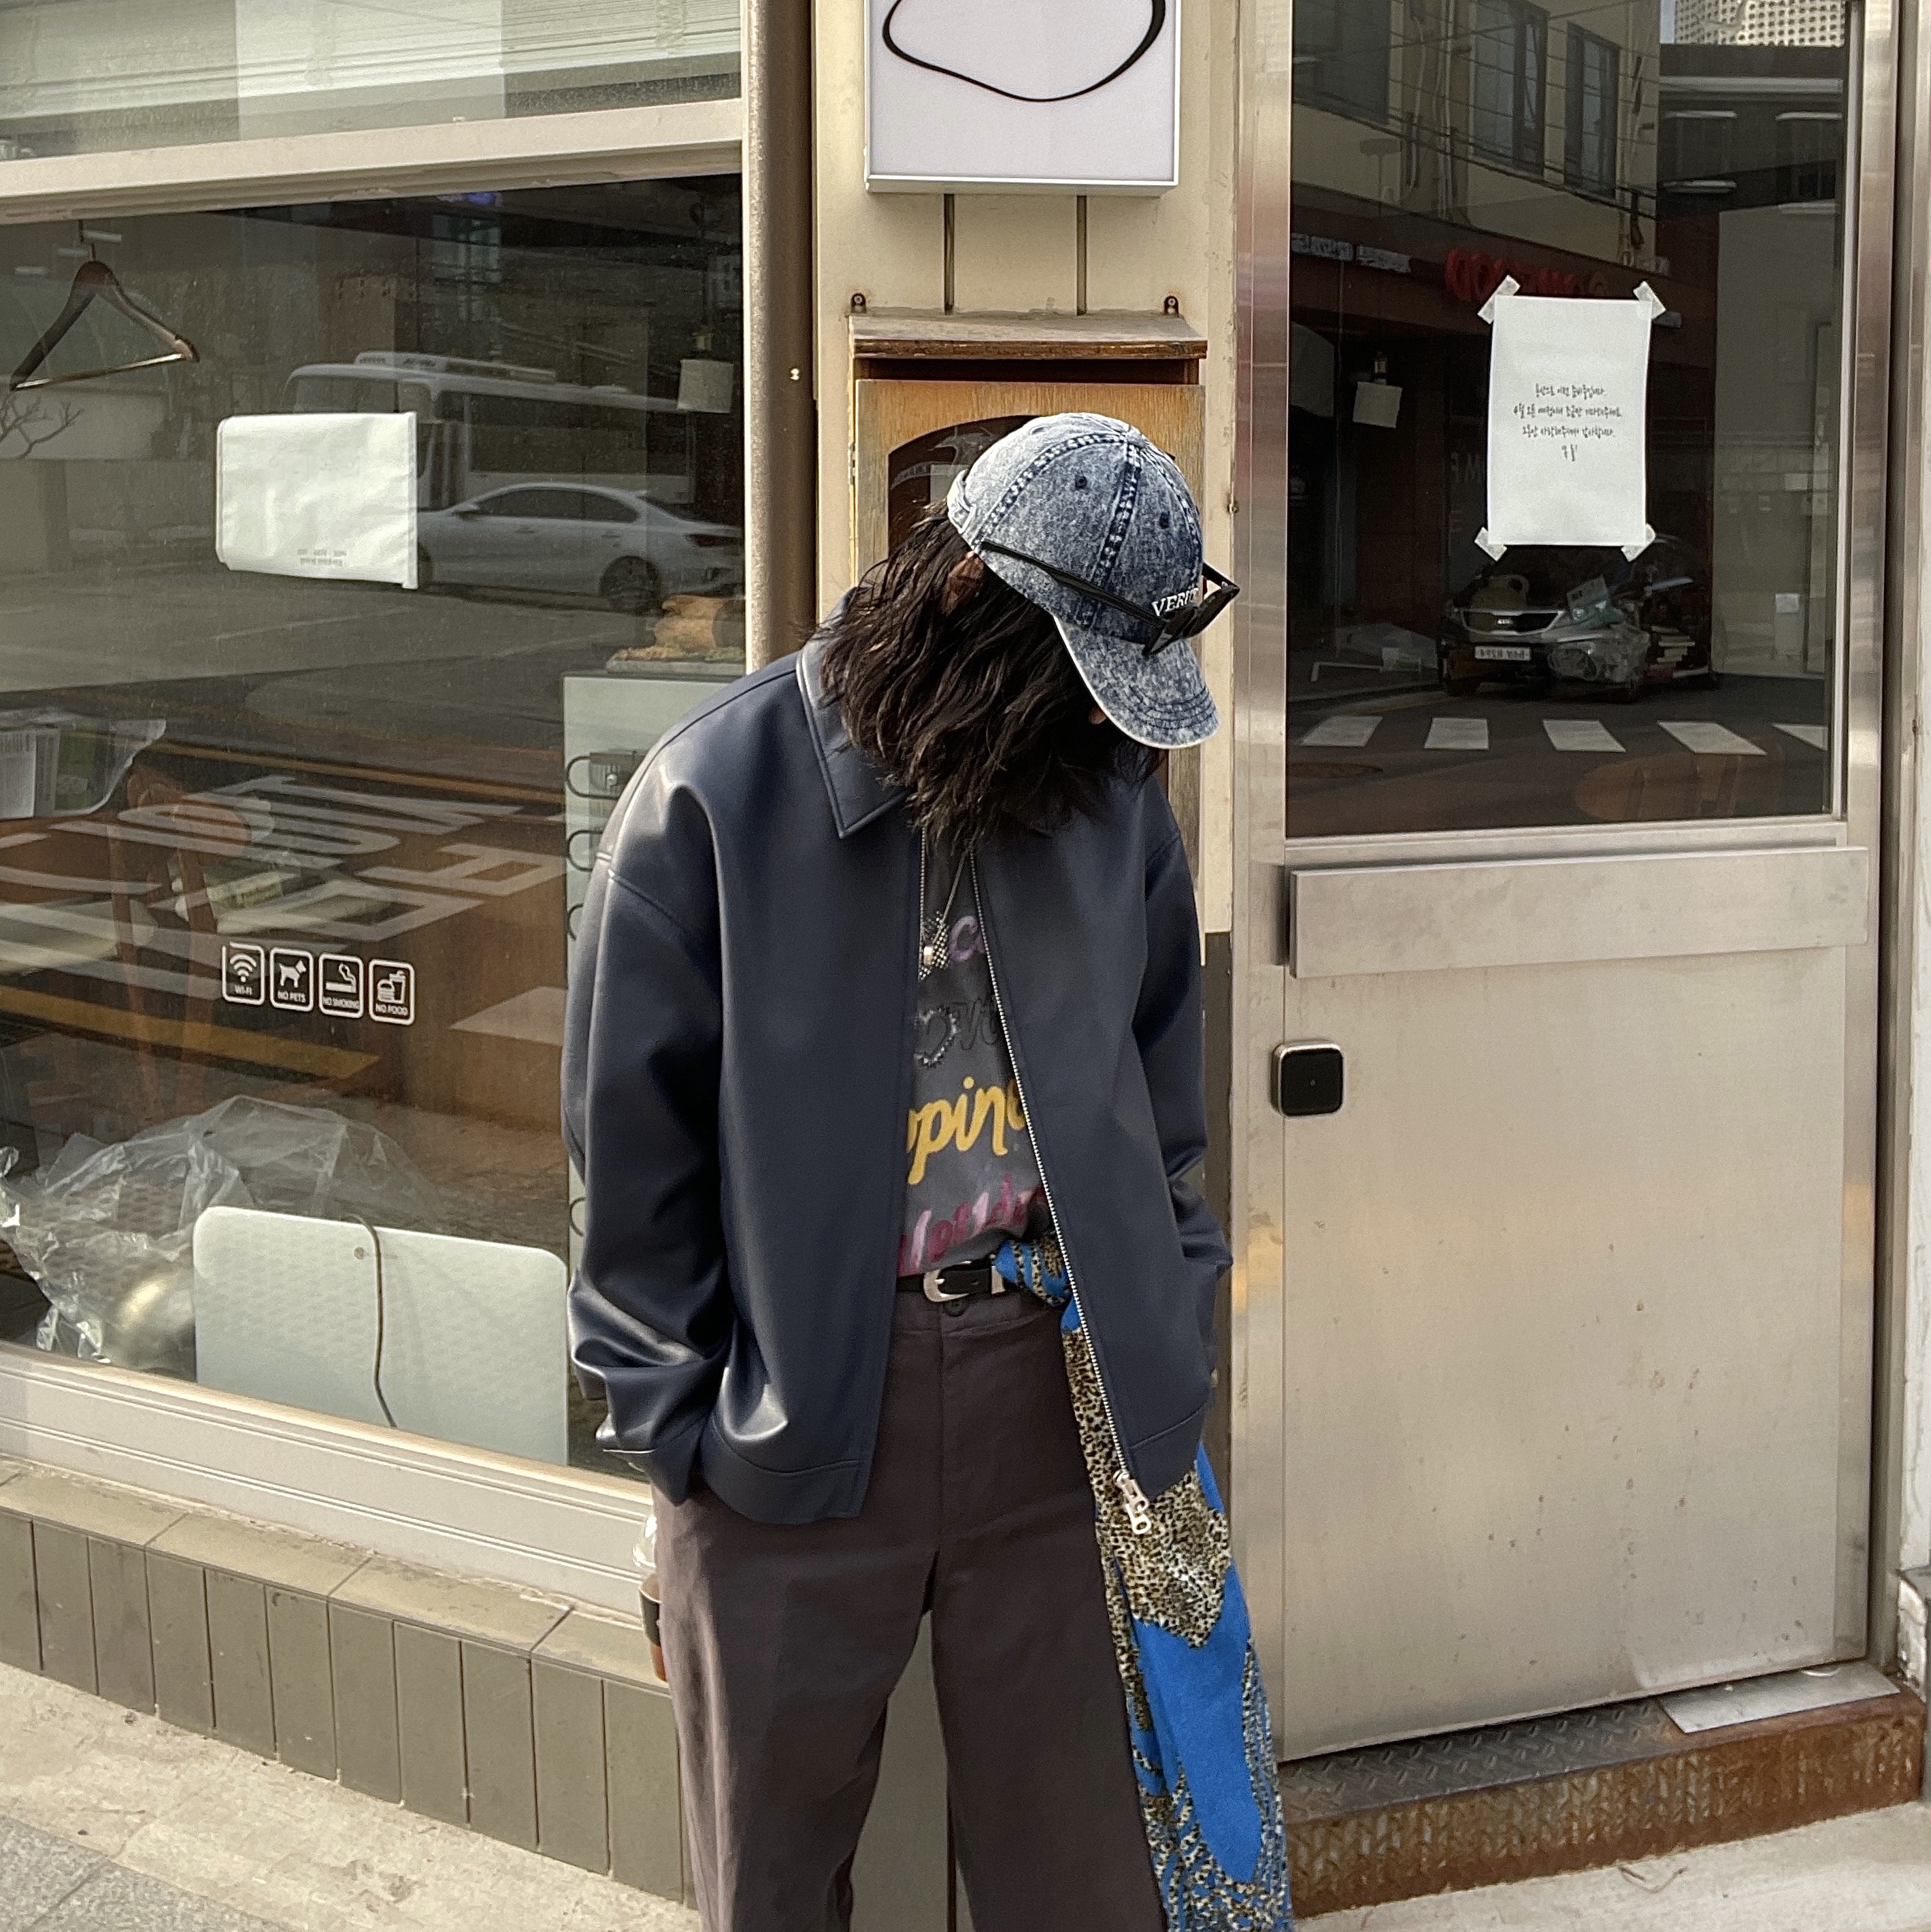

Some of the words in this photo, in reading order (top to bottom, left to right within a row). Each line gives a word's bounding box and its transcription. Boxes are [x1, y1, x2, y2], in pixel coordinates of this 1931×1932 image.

[277, 990, 288, 1000] NO
[289, 992, 306, 1003] PETS
[323, 996, 332, 1006] NO
[333, 998, 360, 1010] SMOKING
[376, 1002, 386, 1013] NO
[387, 1004, 408, 1016] FOOD
